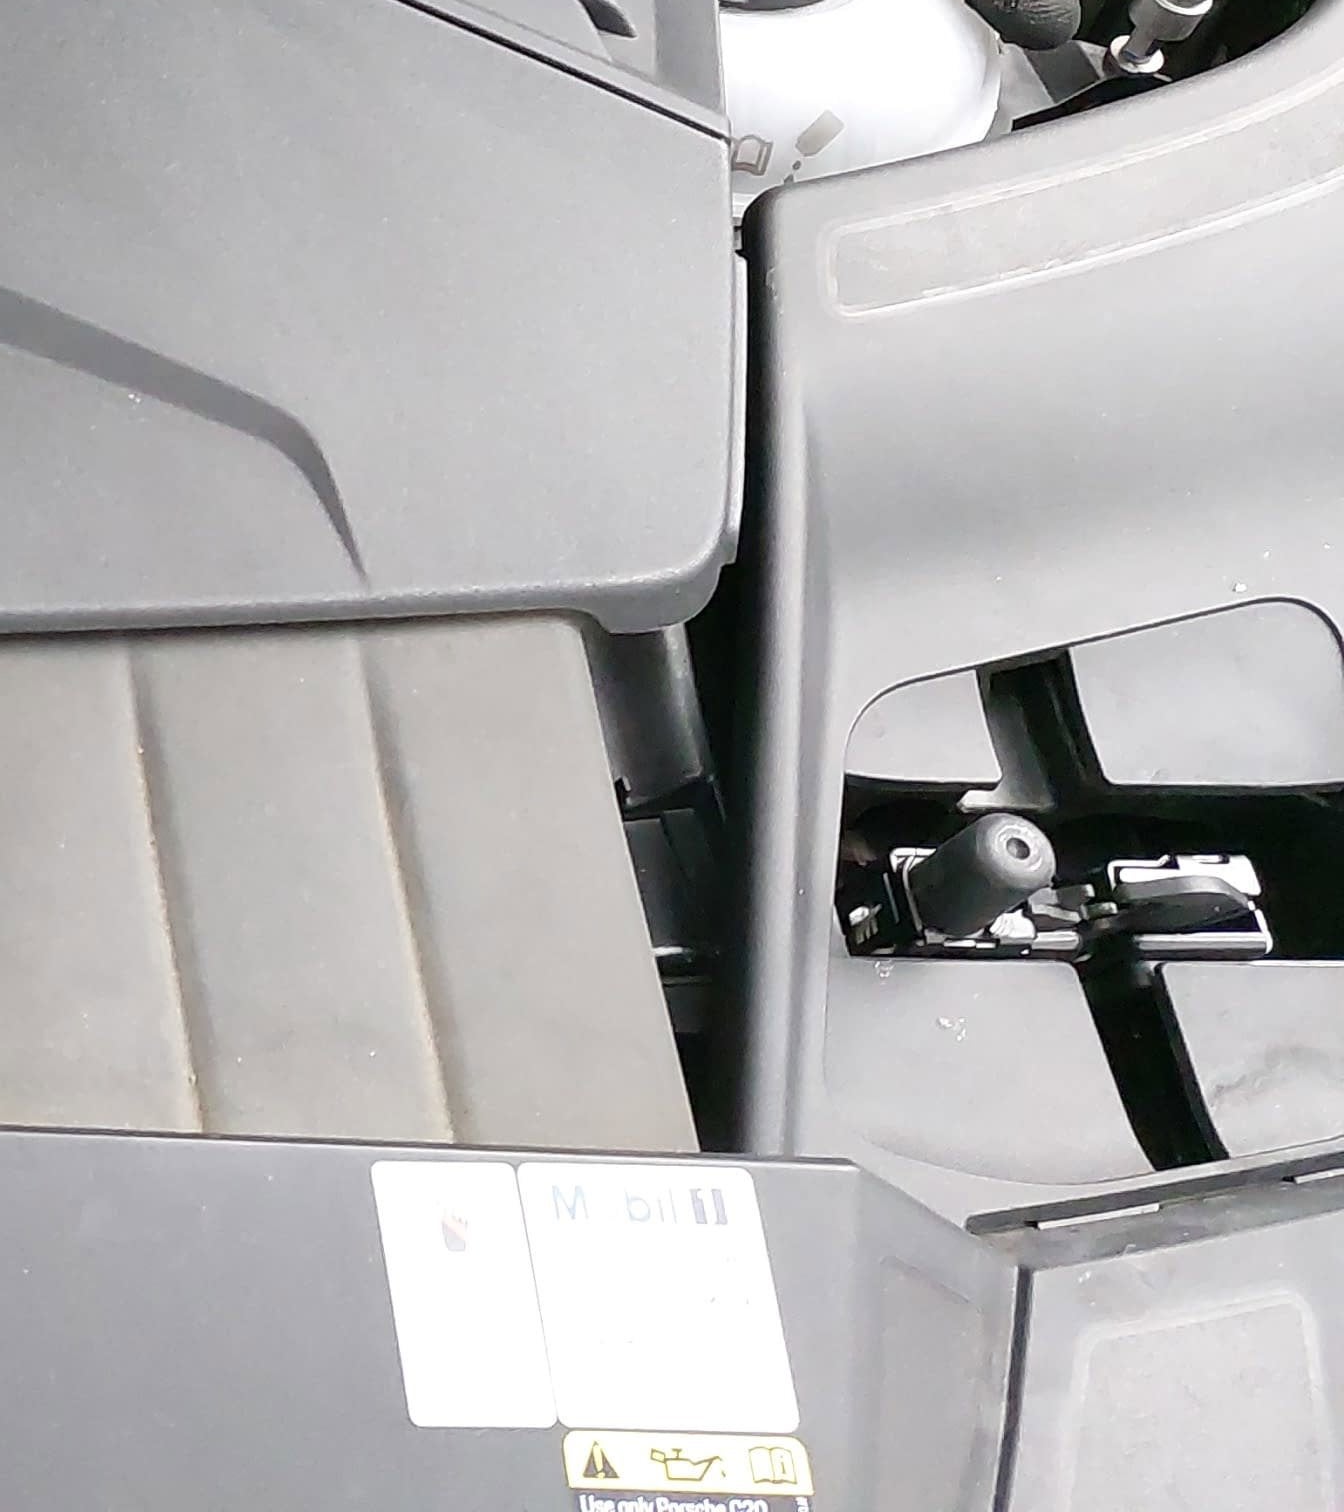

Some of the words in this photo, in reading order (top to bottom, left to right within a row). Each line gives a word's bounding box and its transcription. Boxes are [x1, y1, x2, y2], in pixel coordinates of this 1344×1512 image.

[552, 1185, 677, 1224] Mbil
[578, 1494, 615, 1512] Use
[616, 1496, 653, 1512] only
[655, 1495, 727, 1512] Porsche
